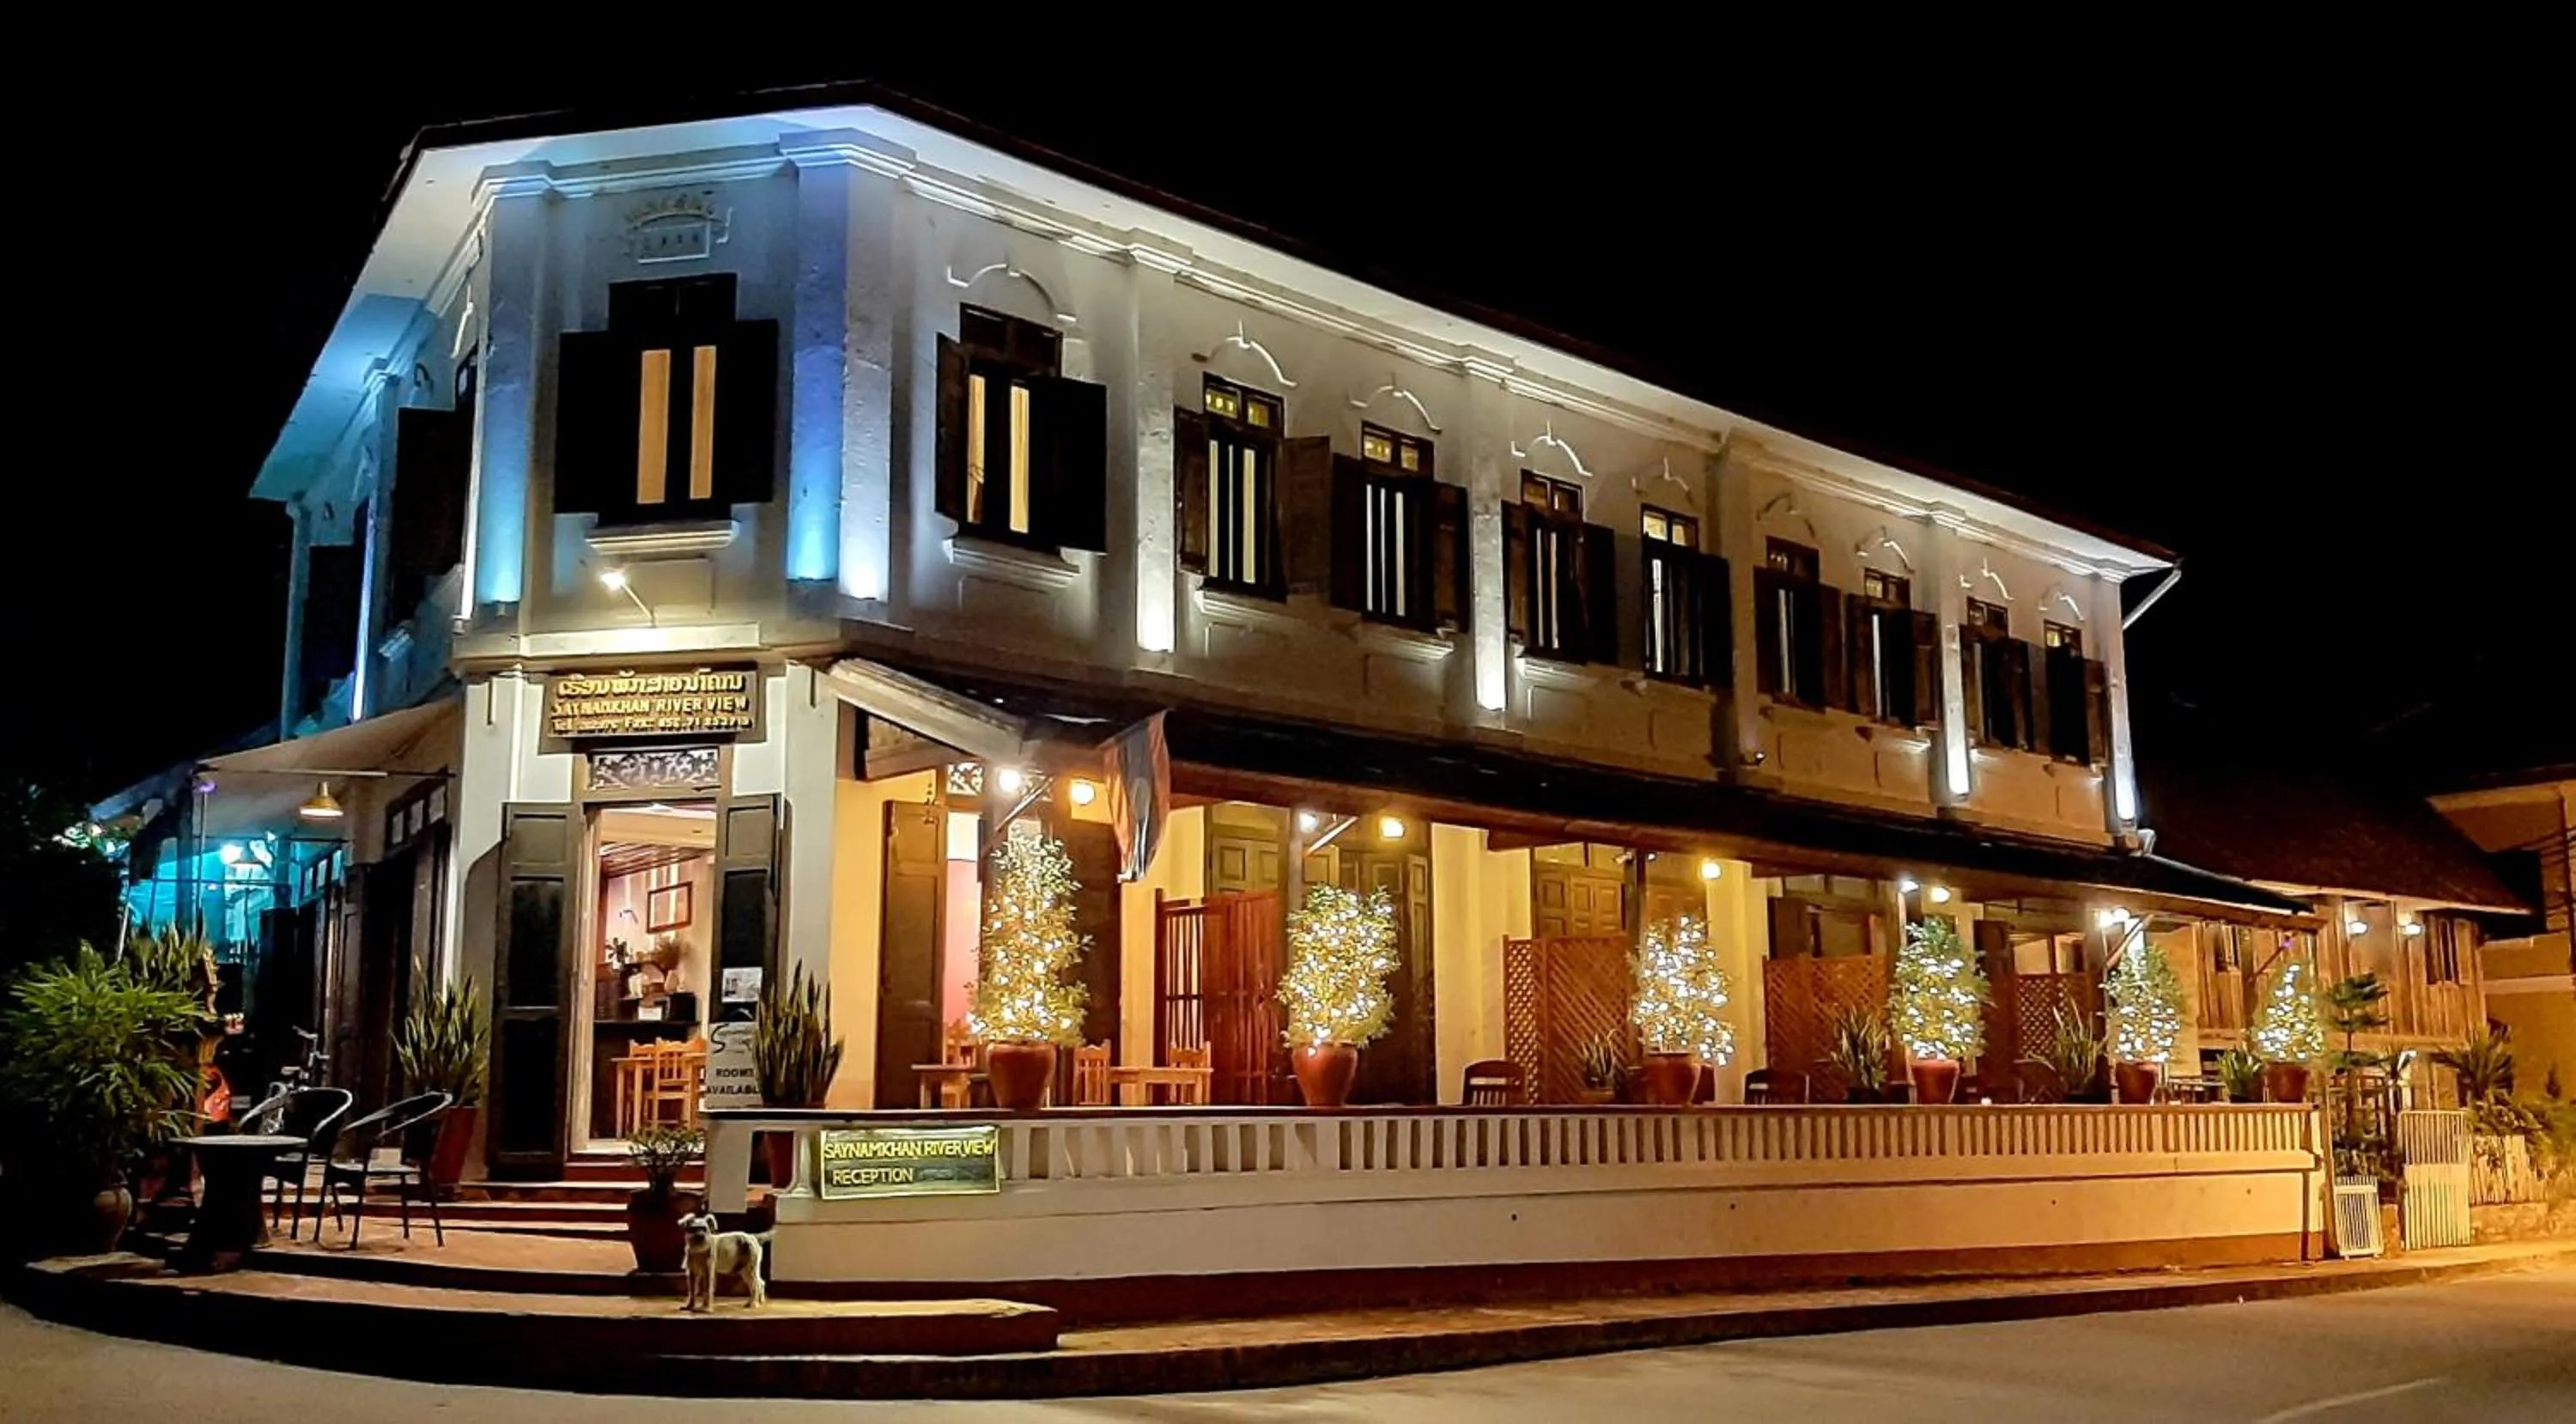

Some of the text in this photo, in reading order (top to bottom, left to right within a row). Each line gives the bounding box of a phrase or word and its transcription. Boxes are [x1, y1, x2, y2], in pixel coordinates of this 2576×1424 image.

[551, 695, 747, 716] SAYNAMKHAN RIVER VIEW
[824, 1140, 996, 1159] SAYNAMKHAN RIVER VIEW
[832, 1168, 914, 1185] RECEPTION
